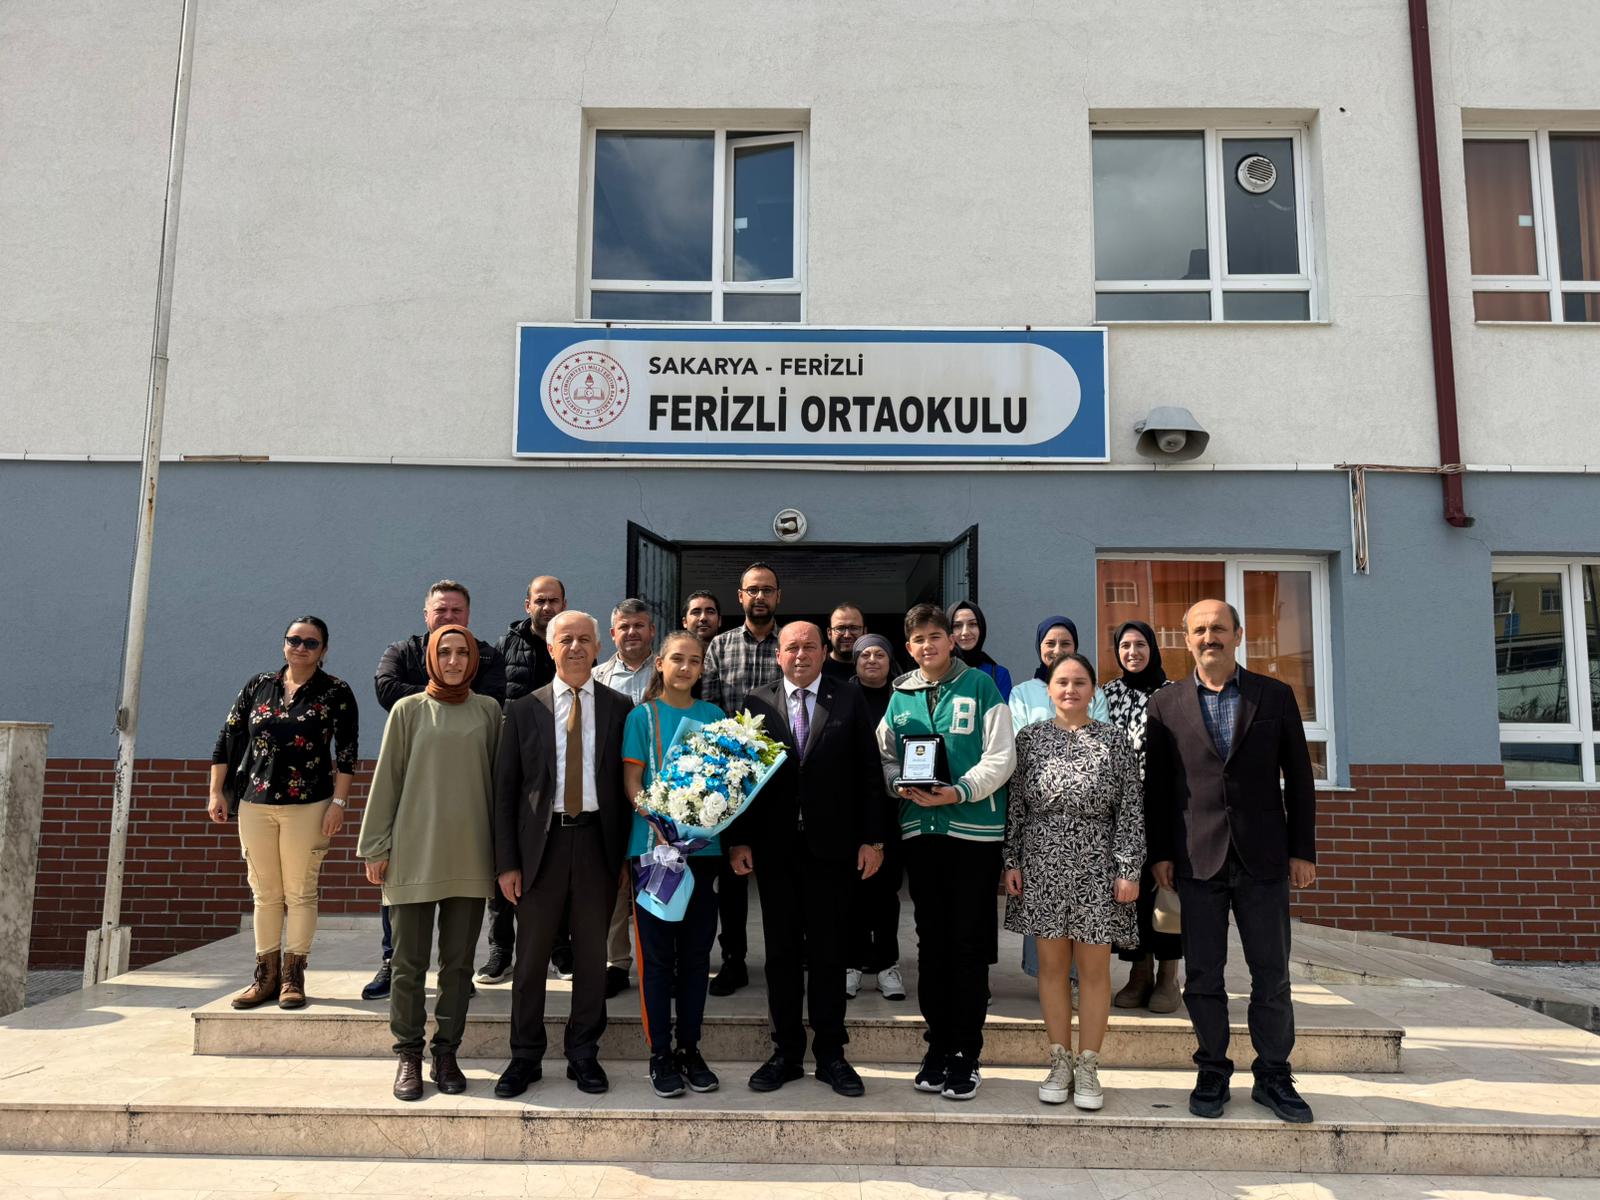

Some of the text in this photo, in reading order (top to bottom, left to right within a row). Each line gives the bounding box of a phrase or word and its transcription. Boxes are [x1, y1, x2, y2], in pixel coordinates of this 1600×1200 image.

[648, 357, 759, 376] SAKARYA
[780, 353, 864, 376] FERİZLİ
[648, 386, 1027, 433] FERİZLİ ORTAOKULU
[949, 697, 976, 735] B
